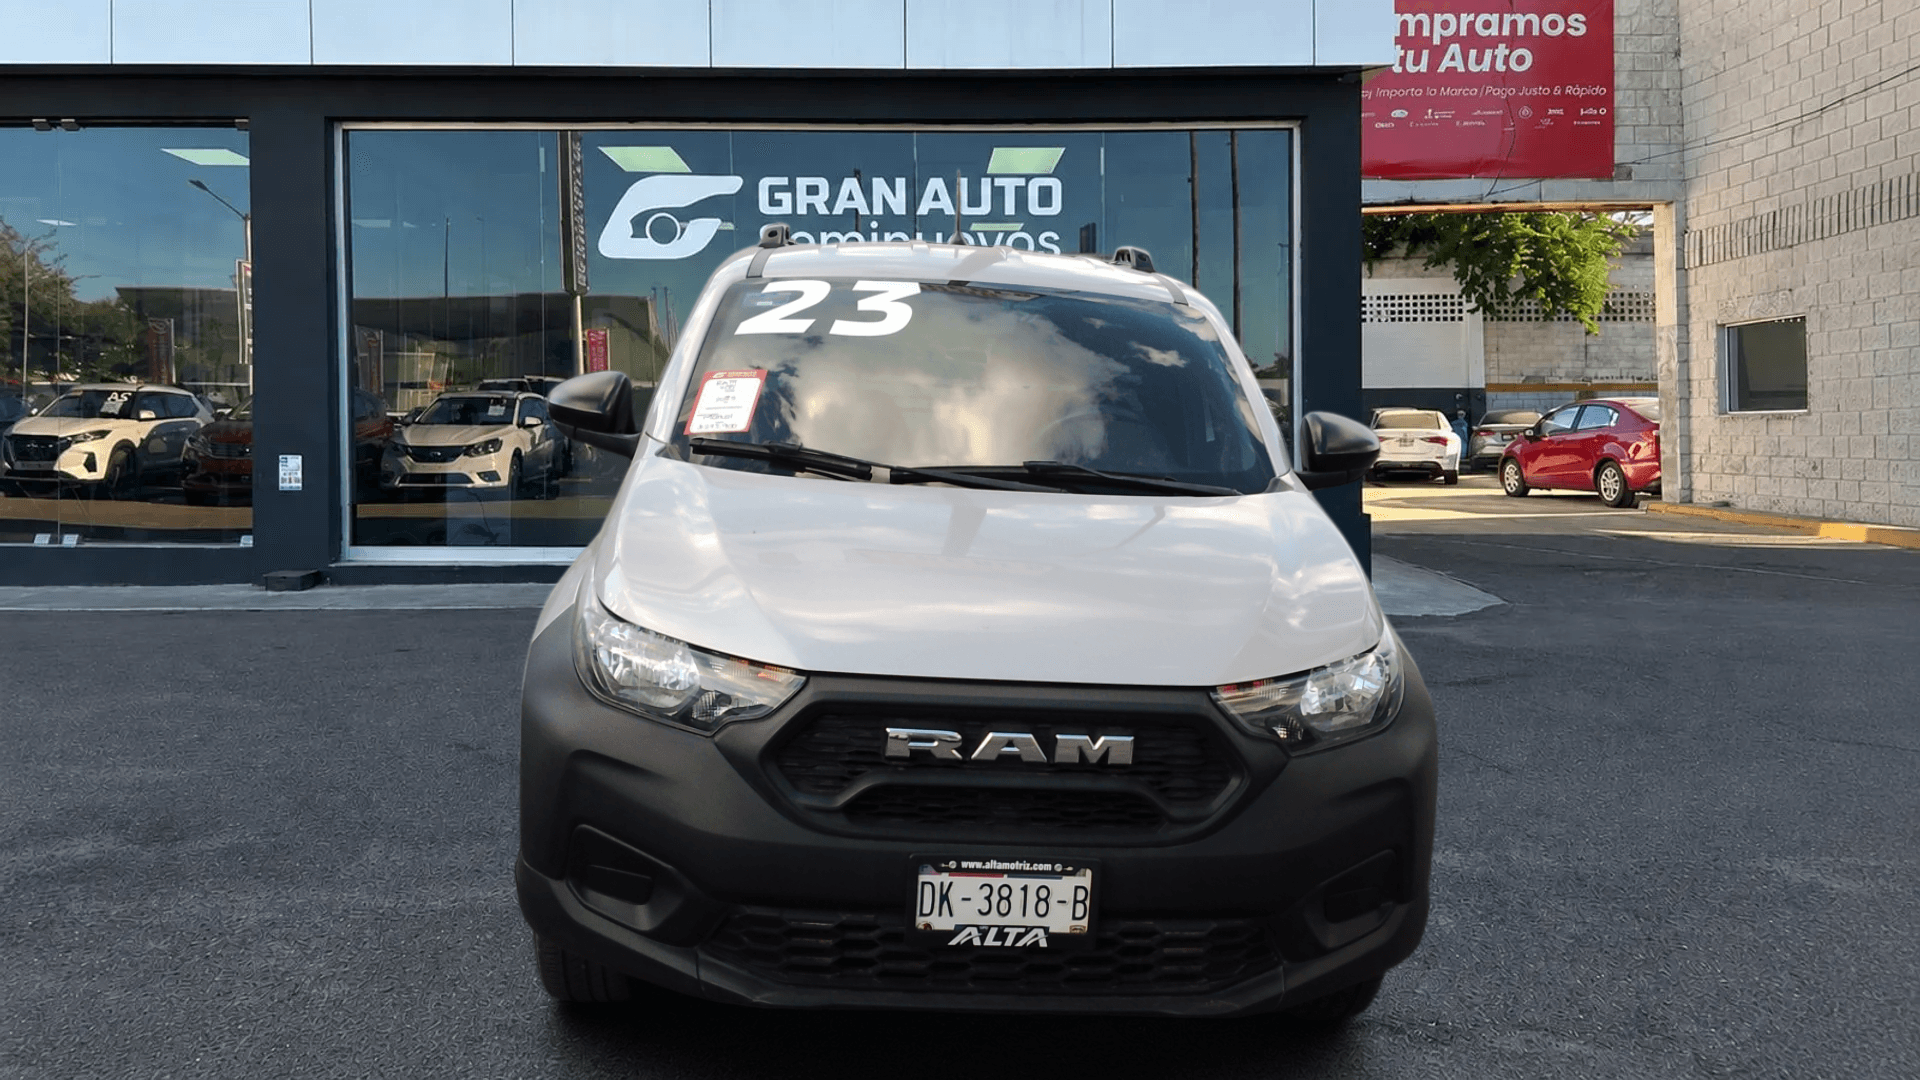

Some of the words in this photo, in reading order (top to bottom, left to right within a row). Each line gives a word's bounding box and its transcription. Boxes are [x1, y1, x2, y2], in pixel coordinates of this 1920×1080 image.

[1393, 44, 1429, 73] tu
[1437, 43, 1533, 73] Auto
[1376, 87, 1423, 99] Importa
[1426, 86, 1437, 97] la
[1440, 86, 1478, 97] Marca
[1519, 86, 1550, 96] Justo
[1553, 85, 1561, 96] &
[758, 176, 906, 216] GRAN
[917, 176, 1062, 216] AUTO
[759, 220, 1061, 255] mivos
[733, 279, 921, 337] 23
[885, 727, 1135, 765] RAM
[961, 859, 1053, 872] www.altamotriz.com
[918, 880, 1089, 921] DK-3818-B
[947, 926, 1049, 948] ALTA
